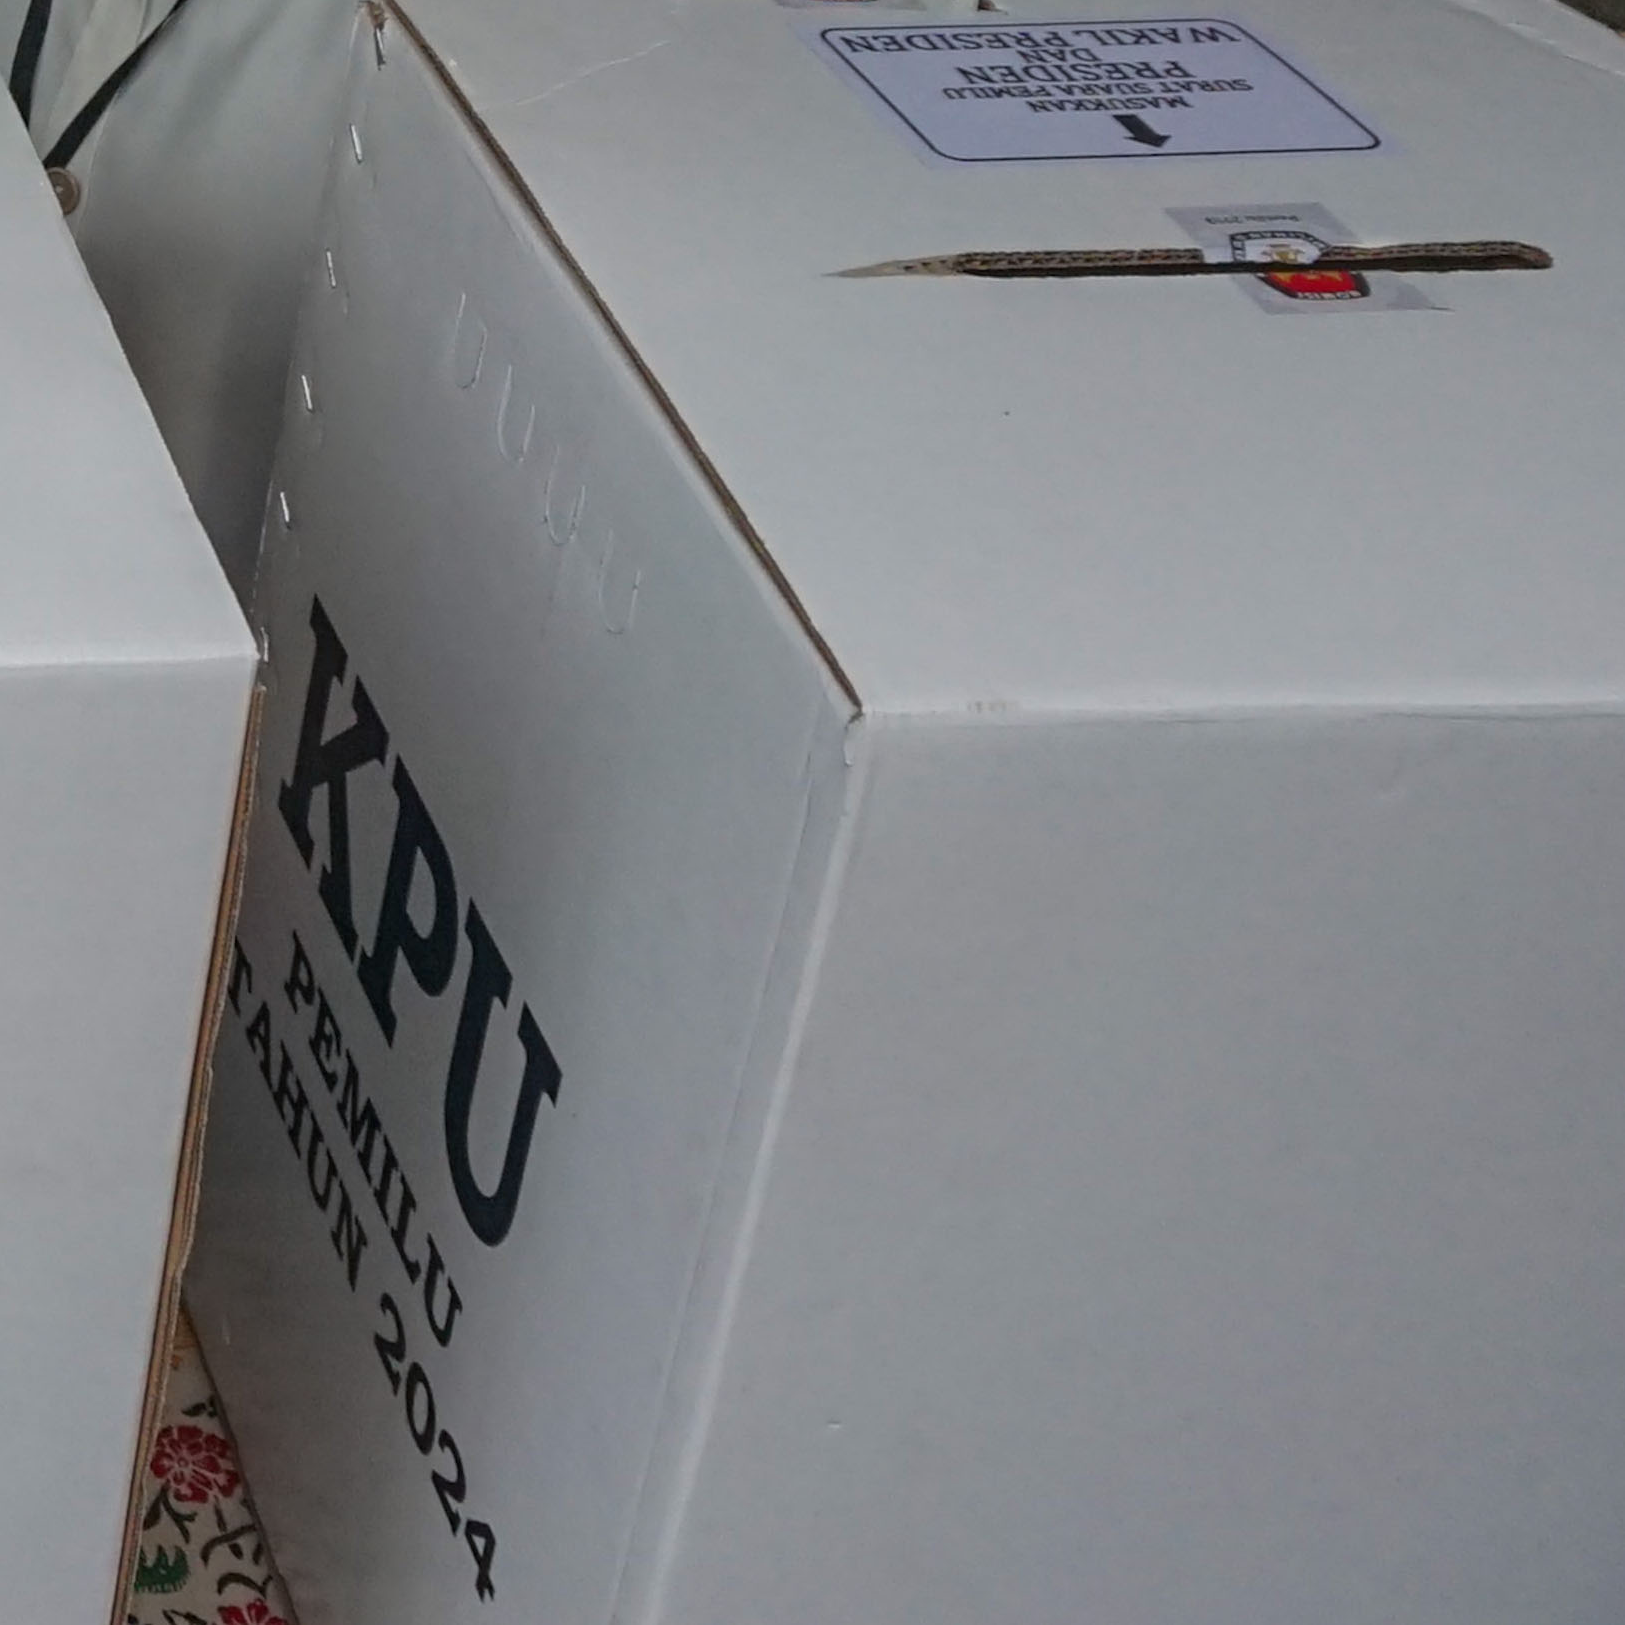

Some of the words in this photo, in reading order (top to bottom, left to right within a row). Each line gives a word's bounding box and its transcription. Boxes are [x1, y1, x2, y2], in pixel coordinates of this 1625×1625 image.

[841, 31, 1076, 54] PRESIDEN
[1075, 27, 1243, 46] WAKIL
[1019, 48, 1103, 65] DAN
[955, 61, 1196, 85] PRESIDEN
[942, 85, 1052, 100] PEMILU
[1055, 82, 1155, 96] SUARA
[1156, 78, 1255, 93] SURAT
[1024, 96, 1196, 113] MASUKKAN
[278, 591, 563, 1247] KPU
[283, 929, 463, 1349] PEMILU
[227, 935, 369, 1292] TAHUN
[372, 1292, 496, 1603] 2024
